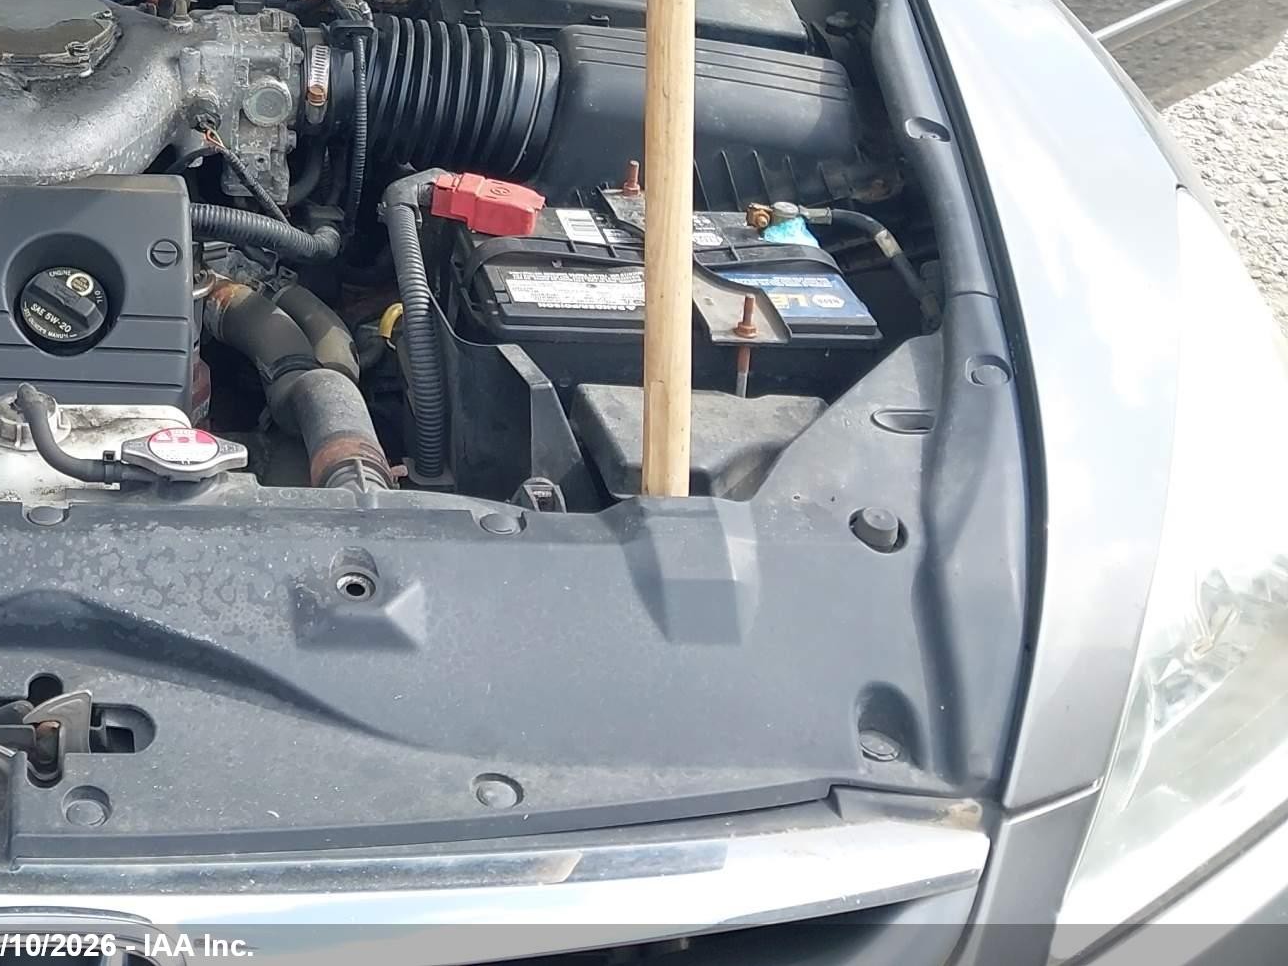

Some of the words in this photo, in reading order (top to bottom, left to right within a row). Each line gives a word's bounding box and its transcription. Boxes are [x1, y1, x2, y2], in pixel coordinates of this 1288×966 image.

[48, 269, 72, 278] ENGINE
[94, 290, 104, 304] OIL
[30, 303, 46, 316] SAE
